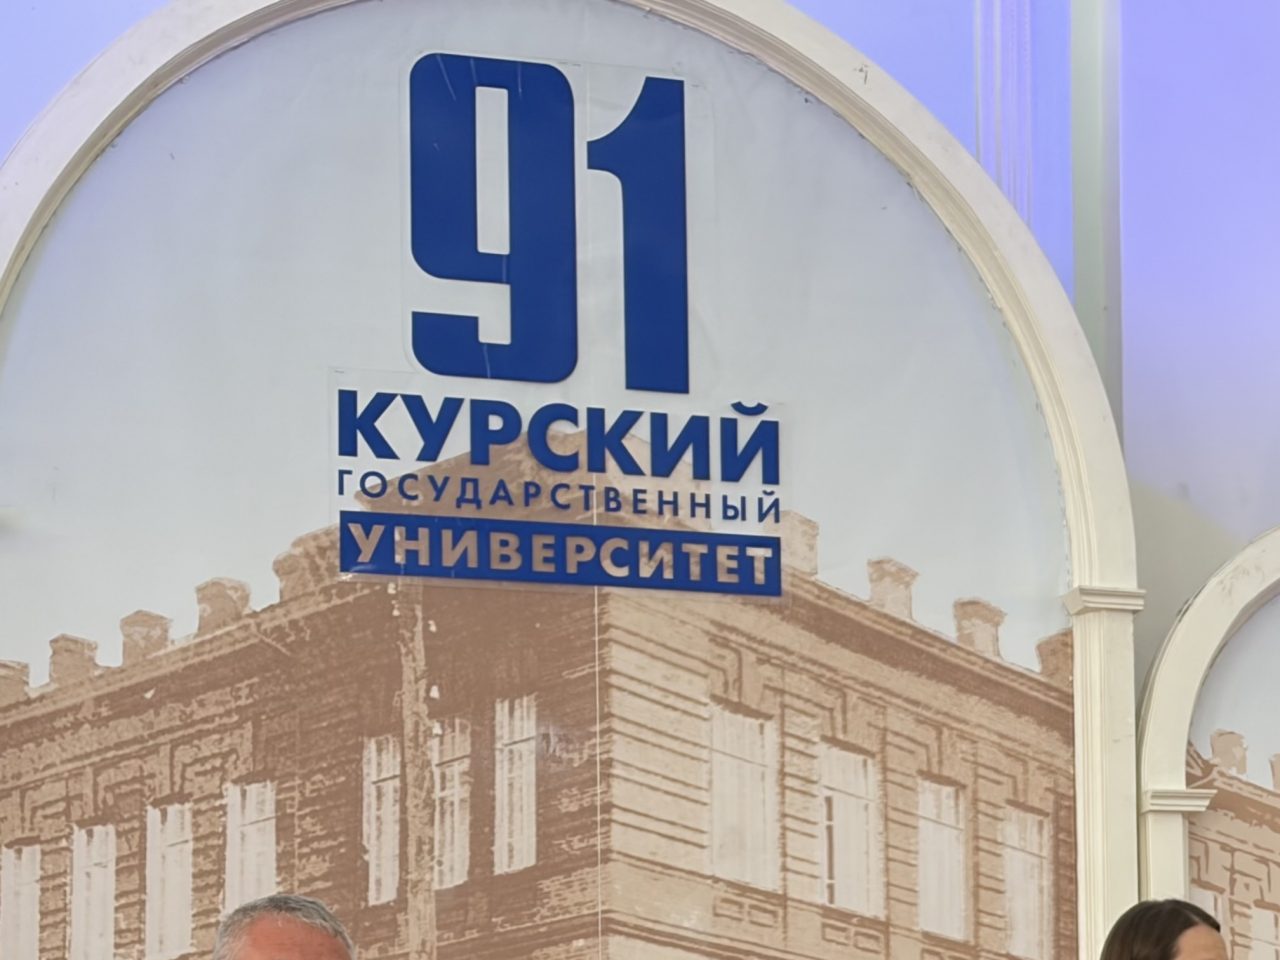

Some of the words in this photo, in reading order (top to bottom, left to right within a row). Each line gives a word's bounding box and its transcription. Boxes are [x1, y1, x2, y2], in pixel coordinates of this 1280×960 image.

[410, 52, 690, 394] 91
[337, 389, 781, 486] КУРСКИЙ
[337, 469, 782, 523] ГОСУДАРСТВЕННЫЙ
[347, 521, 774, 586] УНИВЕРСИТЕТ
